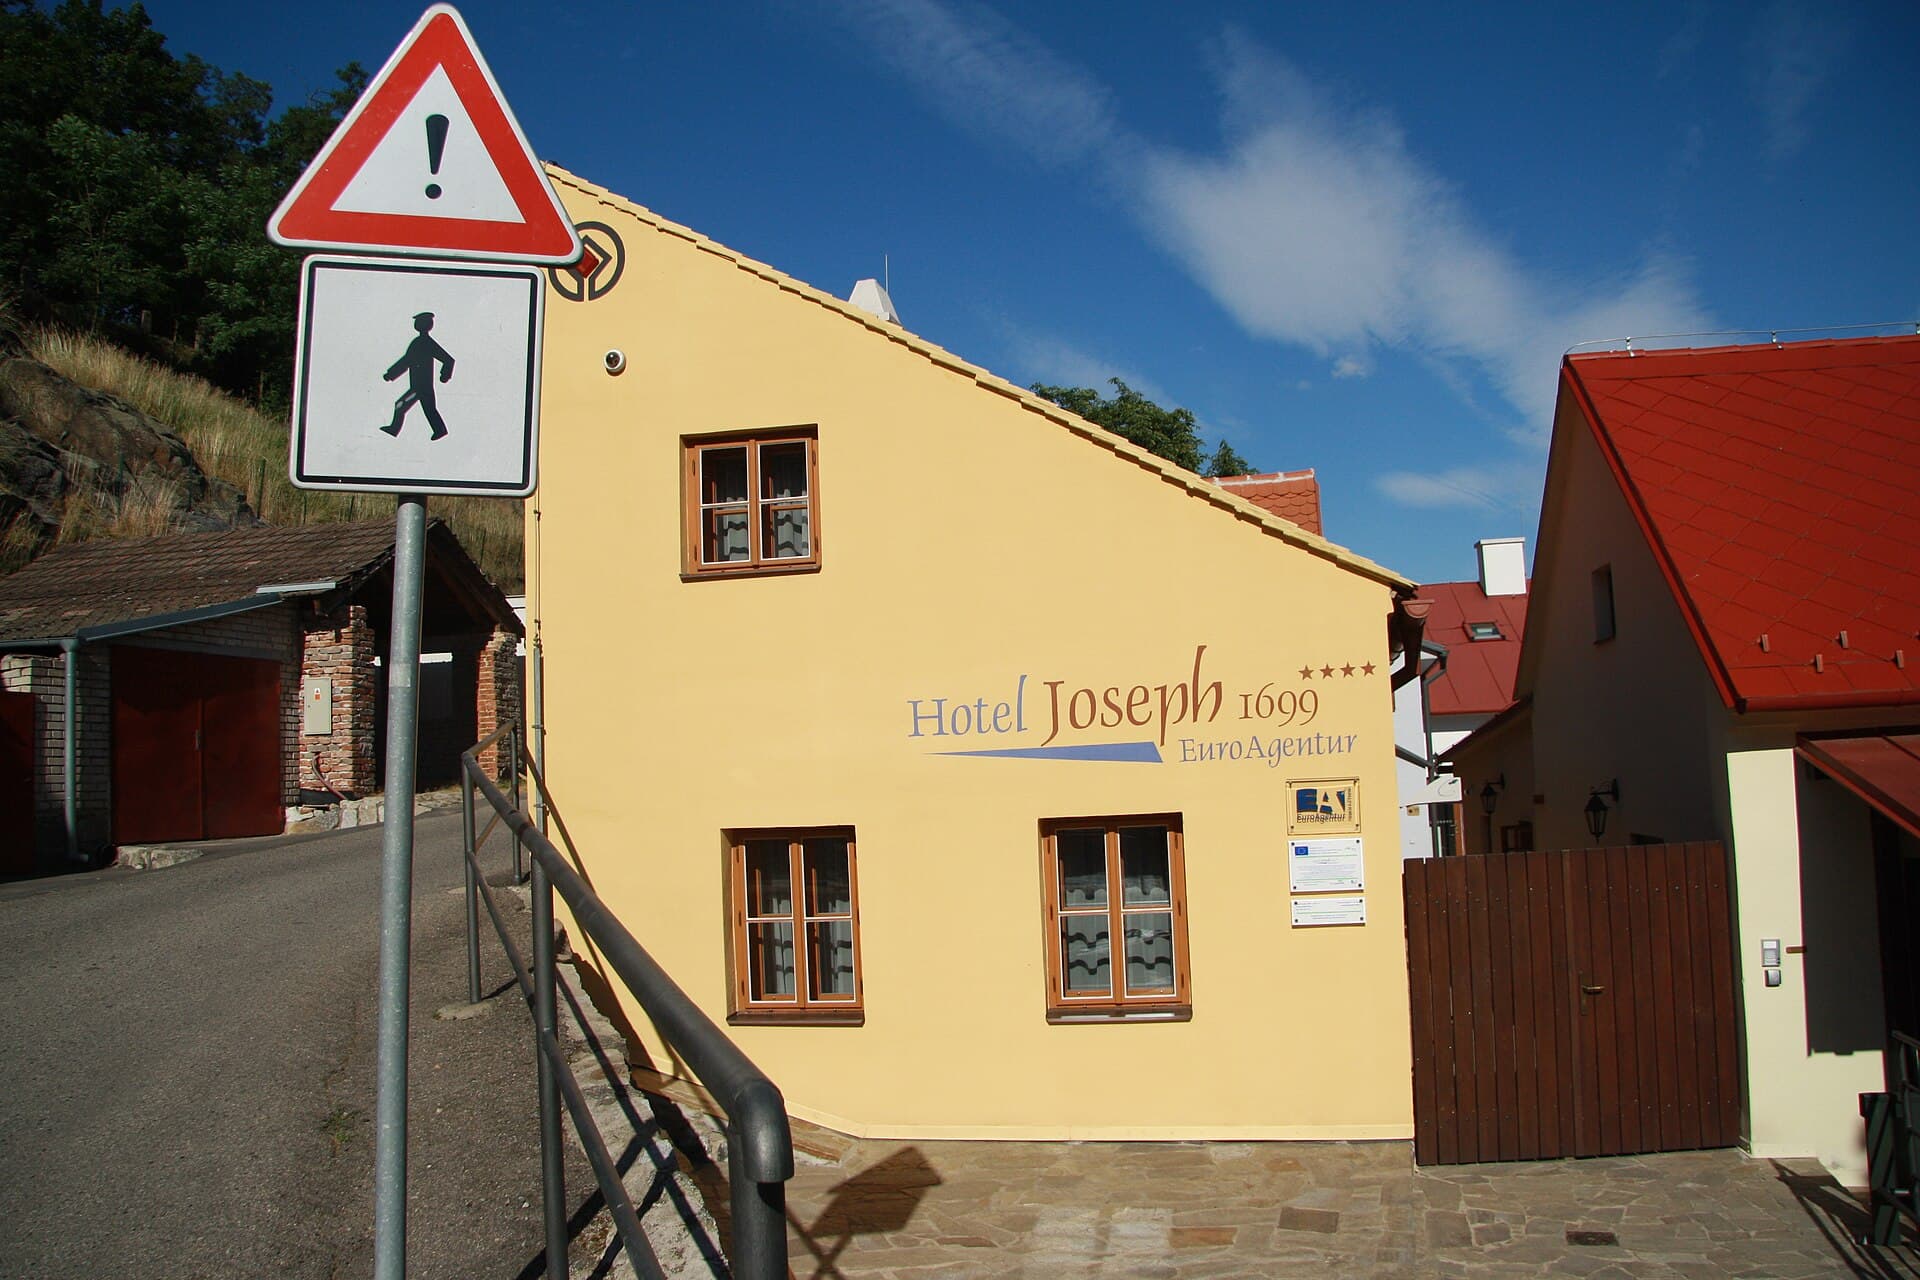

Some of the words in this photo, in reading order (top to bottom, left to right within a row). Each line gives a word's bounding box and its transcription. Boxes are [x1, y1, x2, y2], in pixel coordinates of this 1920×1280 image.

[907, 674, 1028, 738] Hotel
[1041, 645, 1223, 747] Joseph
[1238, 682, 1319, 728] 1699
[1178, 732, 1357, 768] EuroAgentur
